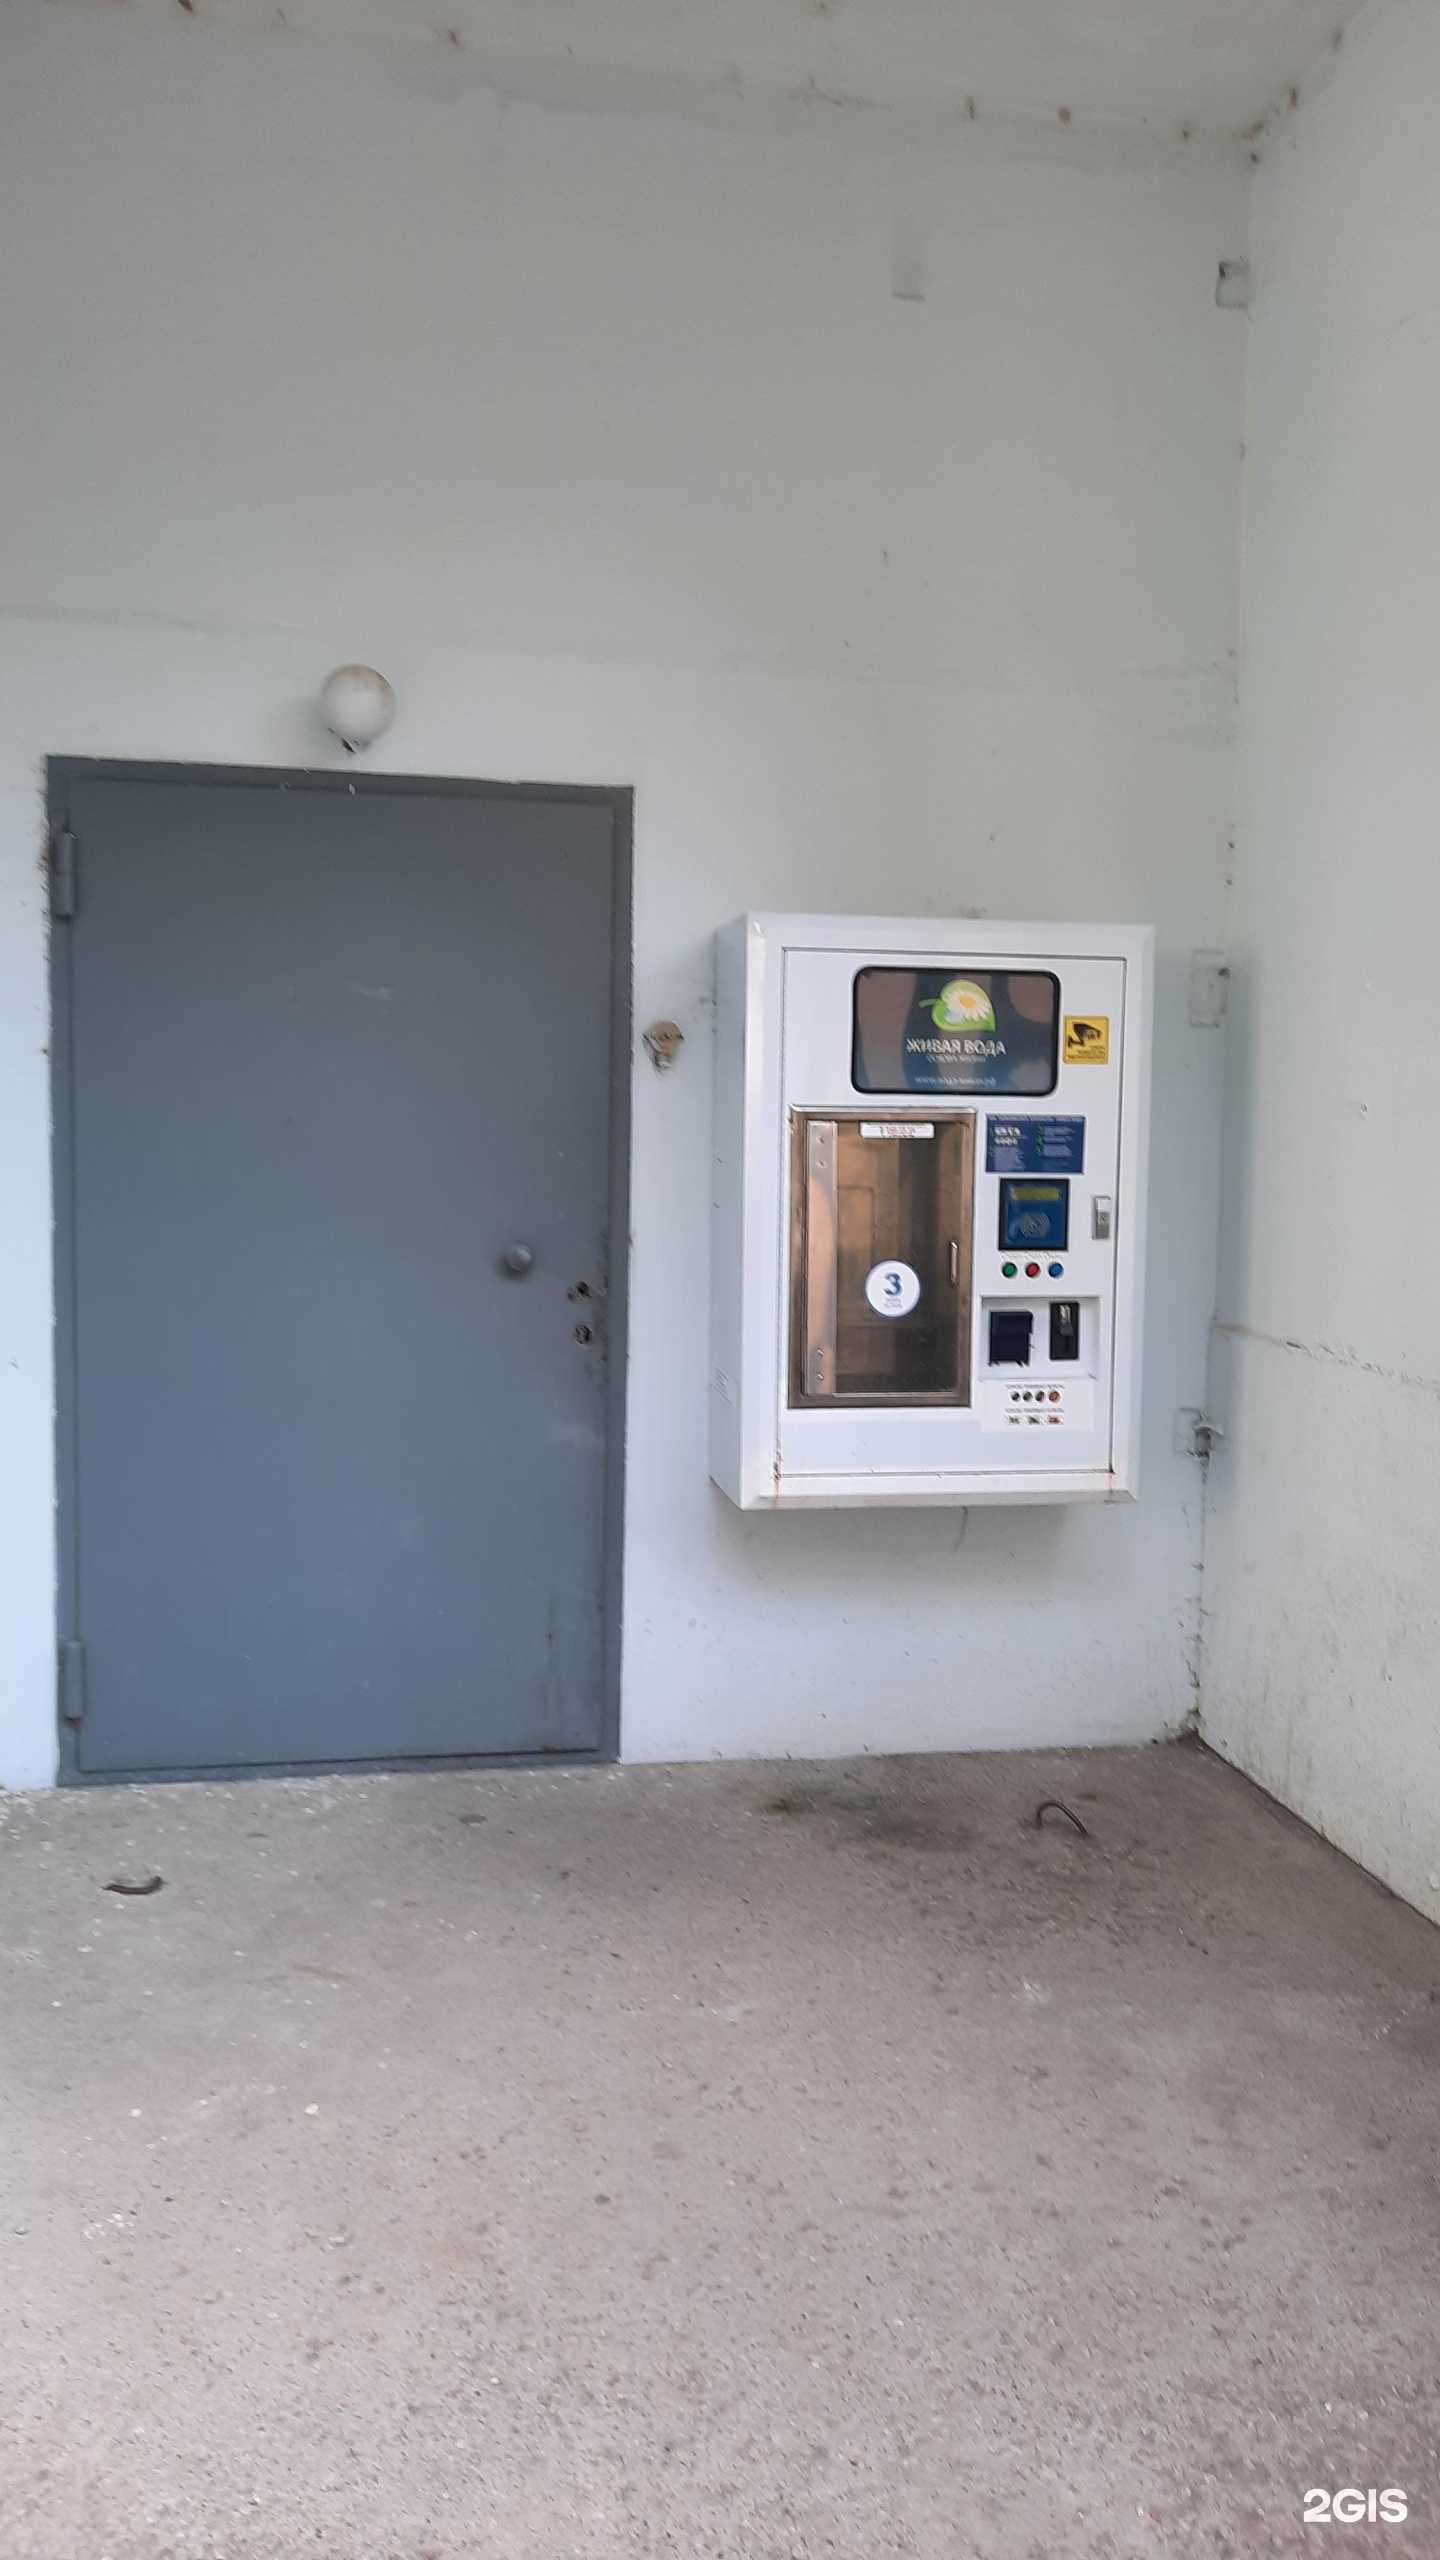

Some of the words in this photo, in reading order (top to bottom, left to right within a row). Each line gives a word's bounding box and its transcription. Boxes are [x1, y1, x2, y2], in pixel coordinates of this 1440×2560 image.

[906, 1038, 961, 1053] ЖИВАЯ
[964, 1039, 1007, 1057] ВОДА
[883, 1273, 903, 1296] 3
